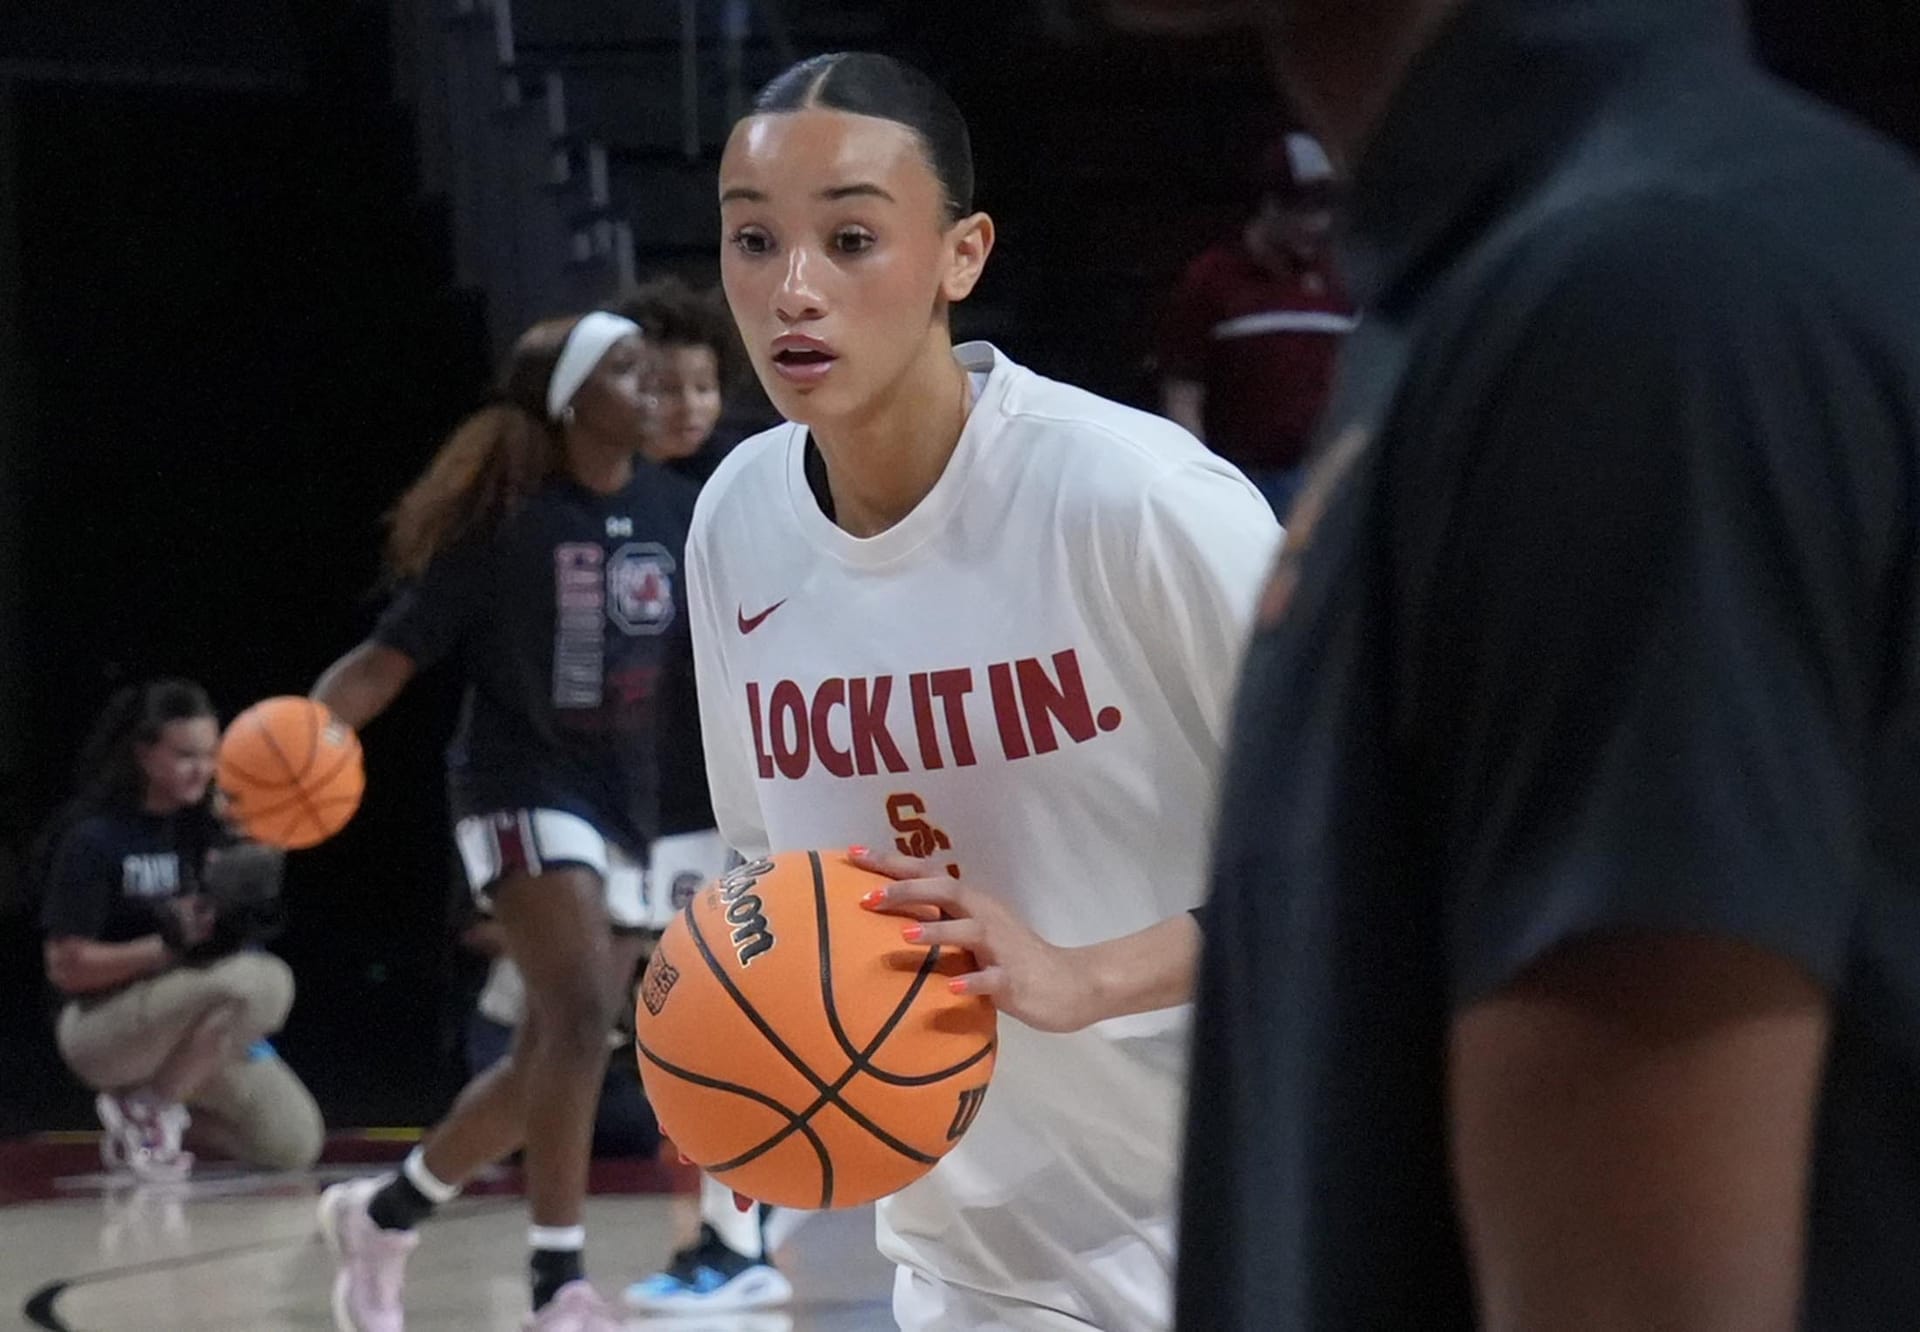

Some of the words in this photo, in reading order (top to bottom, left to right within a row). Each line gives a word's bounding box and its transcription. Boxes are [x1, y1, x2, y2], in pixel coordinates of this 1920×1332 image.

[746, 674, 909, 780] LOCK
[909, 667, 977, 770] IT
[988, 648, 1122, 761] IN.
